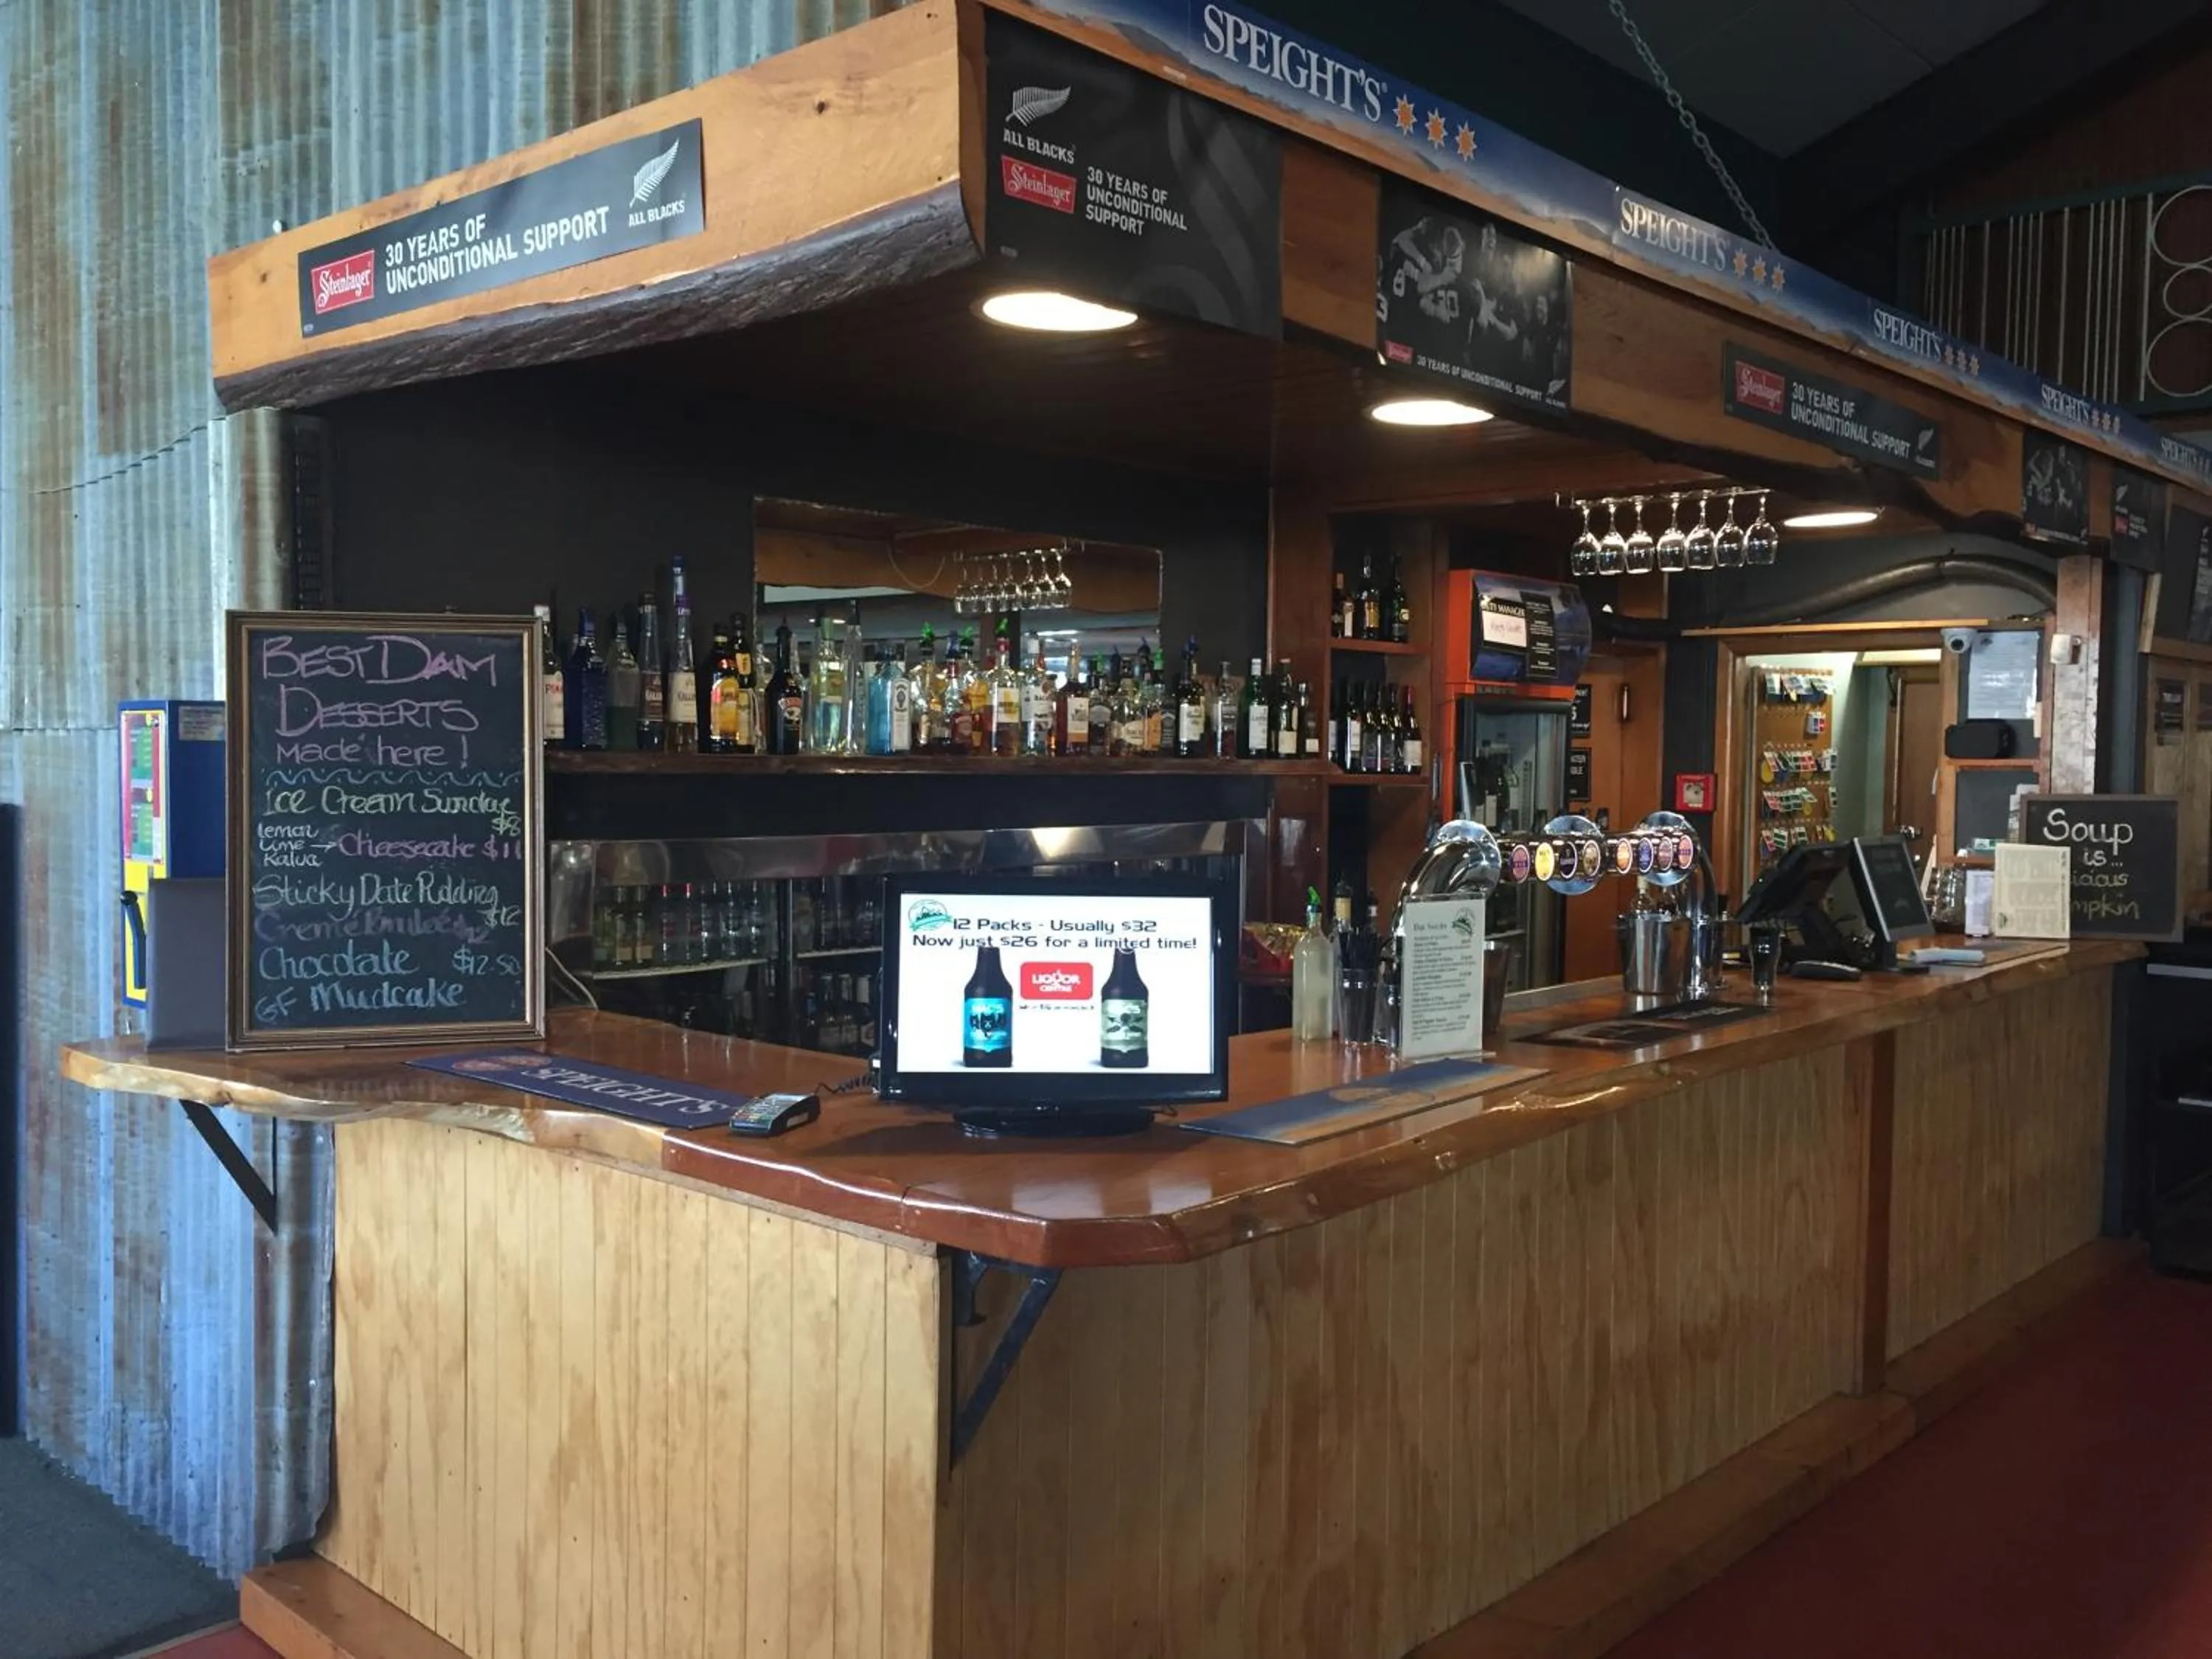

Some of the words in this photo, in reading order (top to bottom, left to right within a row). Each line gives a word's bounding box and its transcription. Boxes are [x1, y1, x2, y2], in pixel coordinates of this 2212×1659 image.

[1203, 4, 1382, 123] SPEIGHT'S
[1004, 128, 1025, 147] ALL
[1028, 139, 1074, 165] BLACKS
[1006, 164, 1072, 210] Steinlager
[1086, 184, 1188, 231] UNCONDITIONAL
[1087, 166, 1103, 184] 30
[1106, 171, 1150, 198] YEARS
[1152, 187, 1168, 204] OF
[628, 212, 645, 227] ALL
[647, 200, 685, 222] BLACKS
[1085, 204, 1145, 236] SUPPORT
[1621, 197, 1728, 272] SPEIGHT'S
[385, 243, 403, 266] 30
[407, 229, 460, 262] YEARS
[465, 213, 487, 242] OF
[386, 233, 518, 294] UNCONDITIONAL
[523, 206, 610, 255] SUPPORT
[317, 260, 372, 307] Steinlager
[1873, 307, 1941, 364] SPEIGHT'S
[1417, 355, 1427, 366] 30
[1427, 357, 1450, 375] YEARS
[1451, 366, 1460, 377] OF
[1461, 369, 1514, 393] UNCONDITIONAL
[1514, 384, 1543, 401] SUPPORT
[1792, 382, 1804, 402] 30
[1806, 387, 1840, 414] YEARS
[1843, 400, 1855, 417] OF
[1791, 403, 1870, 445] UNCONDITIONAL
[1871, 431, 1911, 459] SUPPORT
[262, 636, 374, 679] BEST
[366, 635, 496, 686] DAM
[276, 684, 479, 737] DESSERTS
[262, 788, 316, 815] Ice
[321, 786, 415, 815] Cream
[422, 787, 518, 815] Sundae
[338, 830, 477, 858] Cheesecake
[482, 834, 521, 861] $11
[2042, 808, 2133, 856] Soup
[252, 872, 354, 922] Sticky
[360, 873, 413, 905] Date
[417, 871, 498, 906] Pudding
[913, 935, 953, 946] Now
[959, 936, 993, 949] just
[1000, 936, 1038, 947] $26
[1046, 936, 1071, 947] for
[1077, 938, 1088, 947] a
[1095, 936, 1150, 949] limited
[1157, 937, 1197, 949] time!
[953, 918, 971, 931] 12
[978, 918, 1032, 931] Packs
[1050, 919, 1114, 934] Usually
[1121, 920, 1157, 933] $32
[260, 939, 420, 980] Chocolate
[310, 978, 467, 1012] Mudcake
